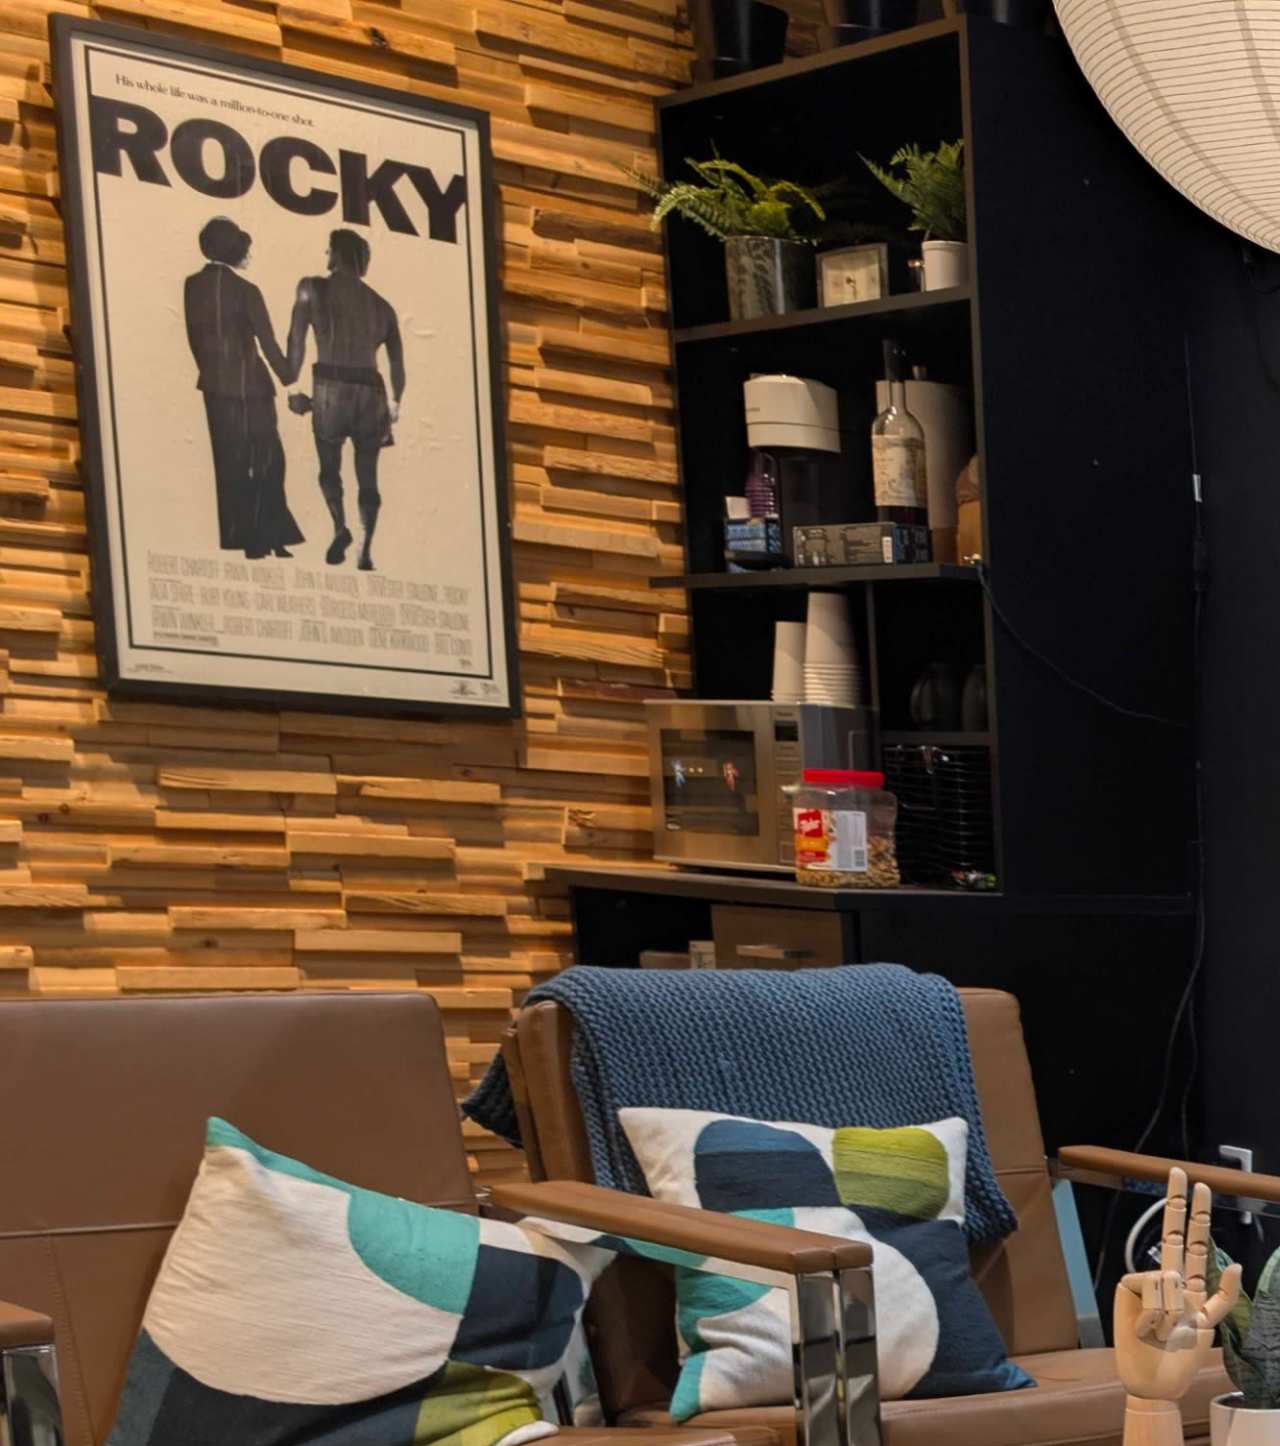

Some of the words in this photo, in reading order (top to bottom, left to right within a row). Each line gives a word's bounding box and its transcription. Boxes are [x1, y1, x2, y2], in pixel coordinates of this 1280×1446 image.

[115, 73, 134, 88] His
[136, 79, 169, 95] whole
[170, 85, 185, 99] life
[187, 94, 209, 105] was
[91, 95, 467, 244] ROCKY
